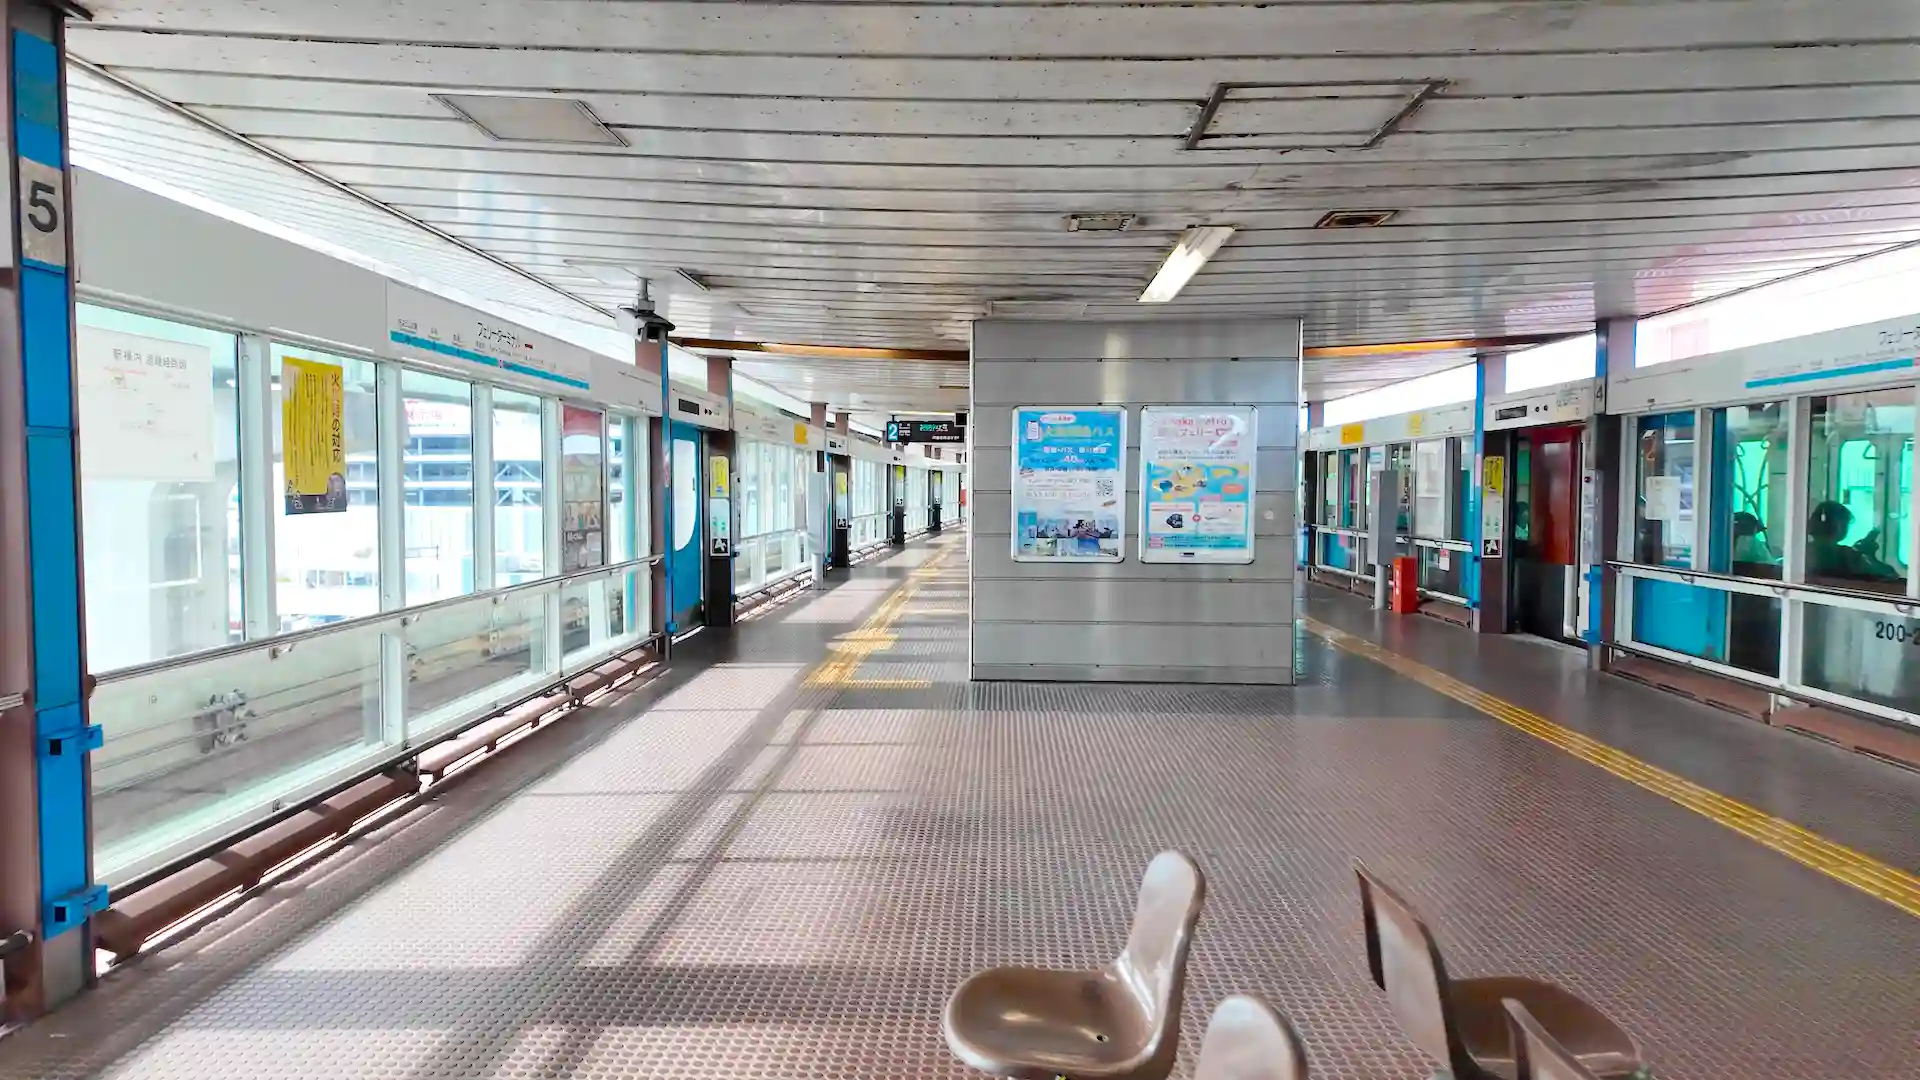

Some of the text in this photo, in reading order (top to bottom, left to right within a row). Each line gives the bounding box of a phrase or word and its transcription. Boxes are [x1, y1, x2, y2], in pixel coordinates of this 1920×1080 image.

[28, 180, 58, 233] 5
[1596, 384, 1604, 402] 4
[888, 423, 898, 440] 2
